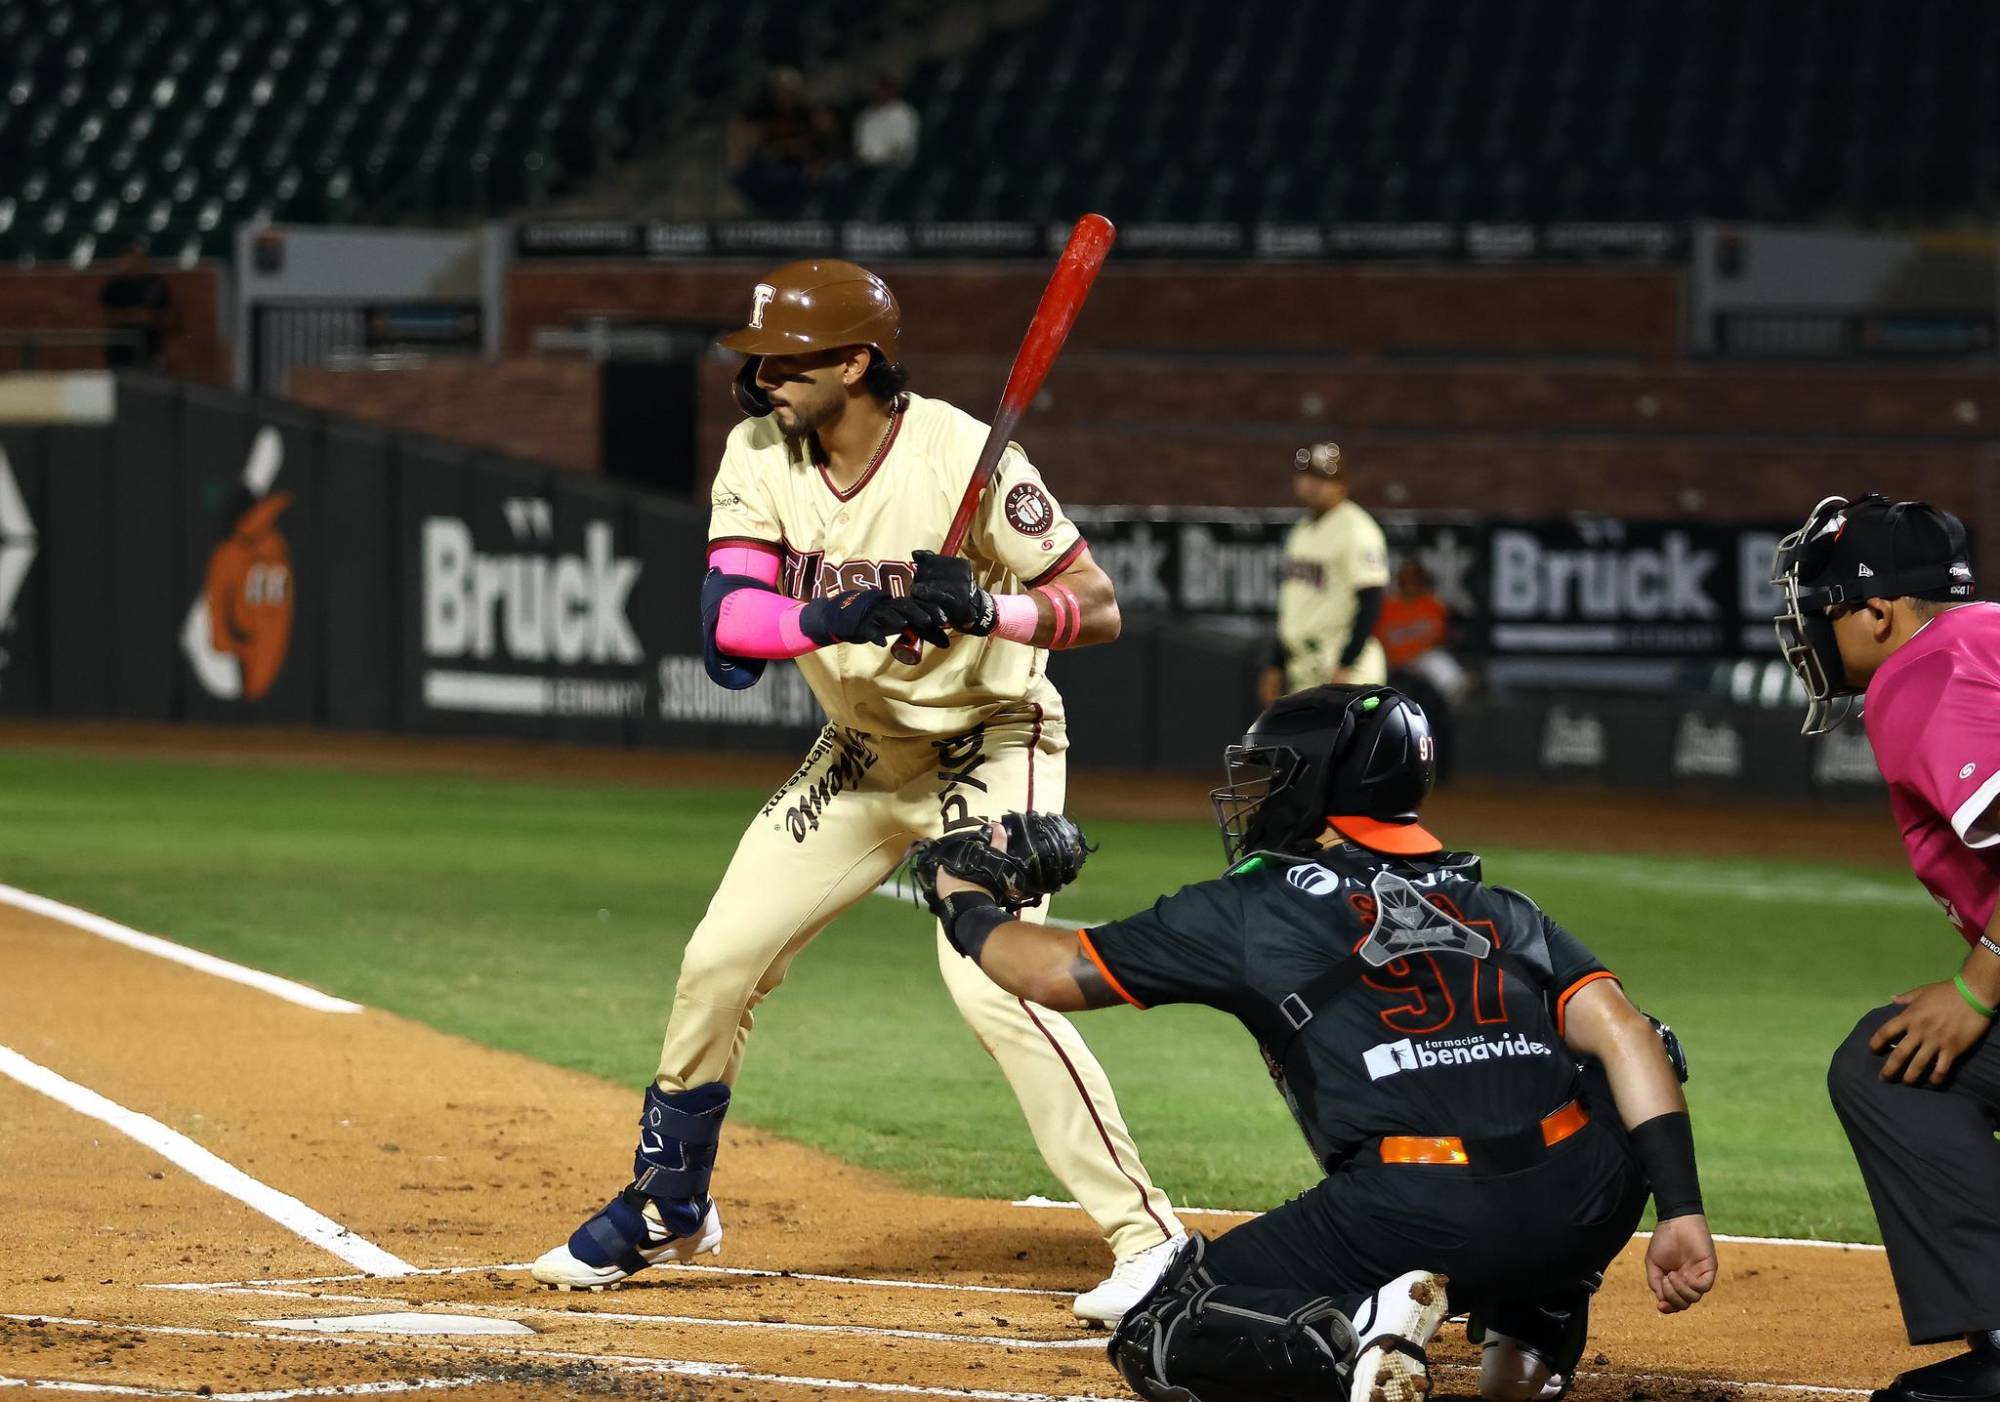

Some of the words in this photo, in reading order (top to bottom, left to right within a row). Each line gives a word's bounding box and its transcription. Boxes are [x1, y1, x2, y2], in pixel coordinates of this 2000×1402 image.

[1007, 485, 1042, 520] TUCSON
[421, 497, 643, 664] Brück
[1489, 518, 1720, 622] Brück
[1418, 736, 1434, 762] 97
[1352, 916, 1509, 1035] 97
[1425, 1034, 1485, 1050] farmacias
